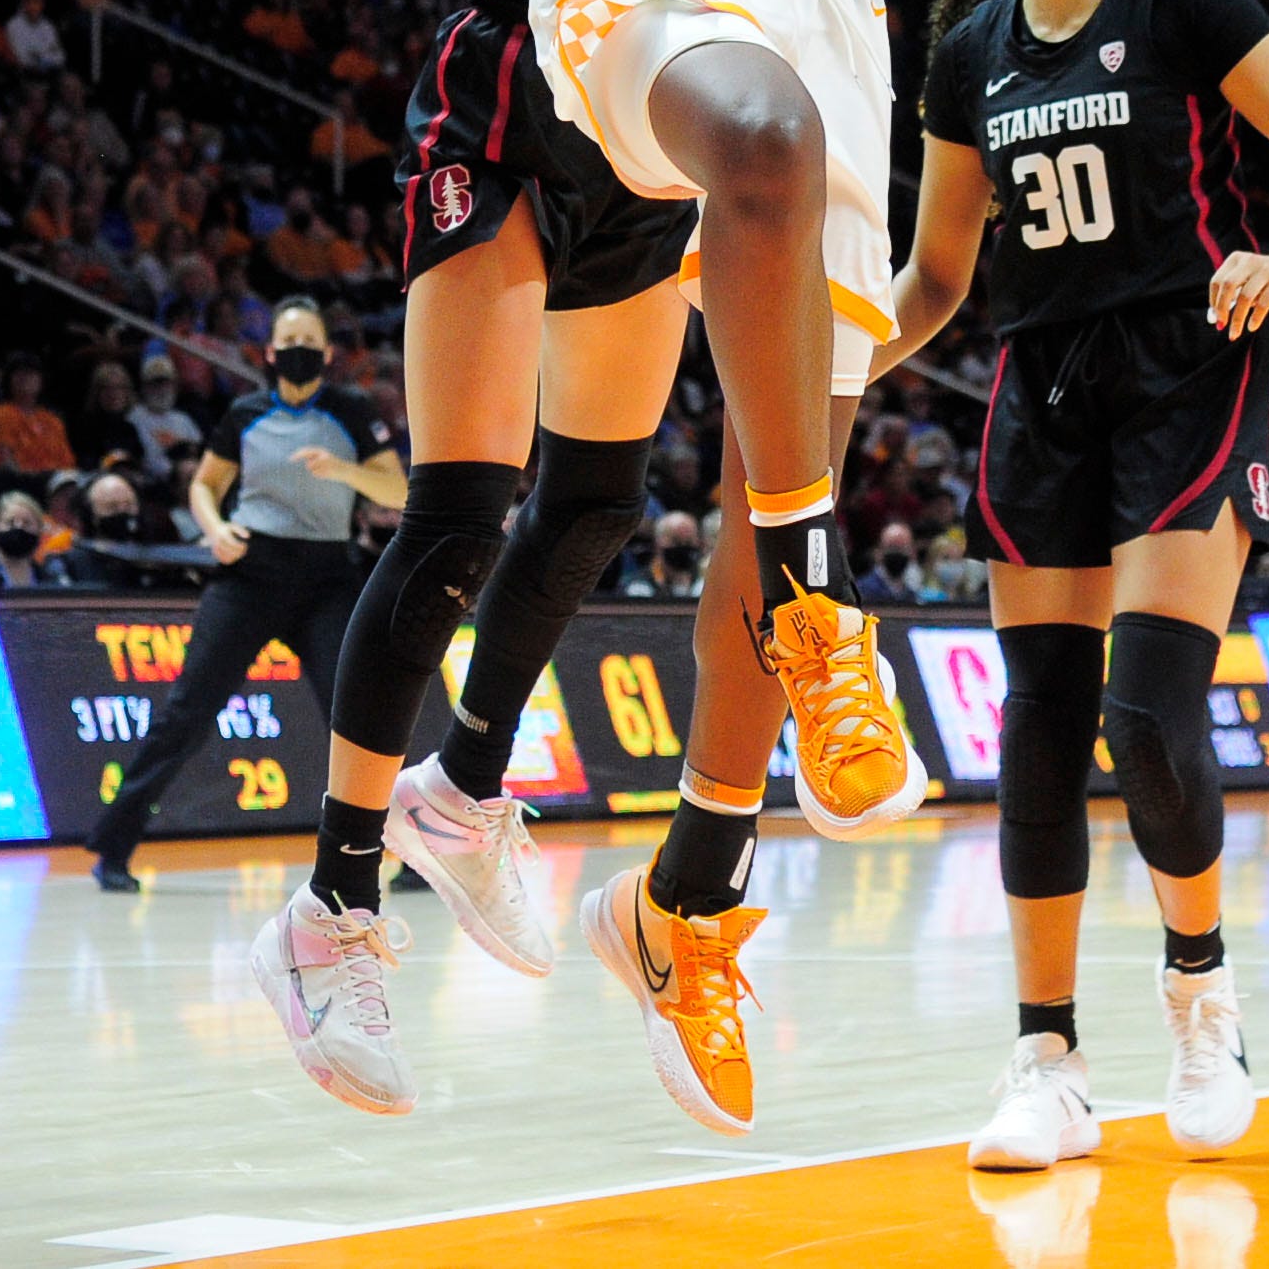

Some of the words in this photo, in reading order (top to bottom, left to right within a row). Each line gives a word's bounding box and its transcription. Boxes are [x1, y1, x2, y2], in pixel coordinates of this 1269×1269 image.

[986, 91, 1130, 152] STANFORD
[1011, 144, 1115, 250] 30
[599, 653, 682, 757] 61
[228, 757, 289, 811] 29
